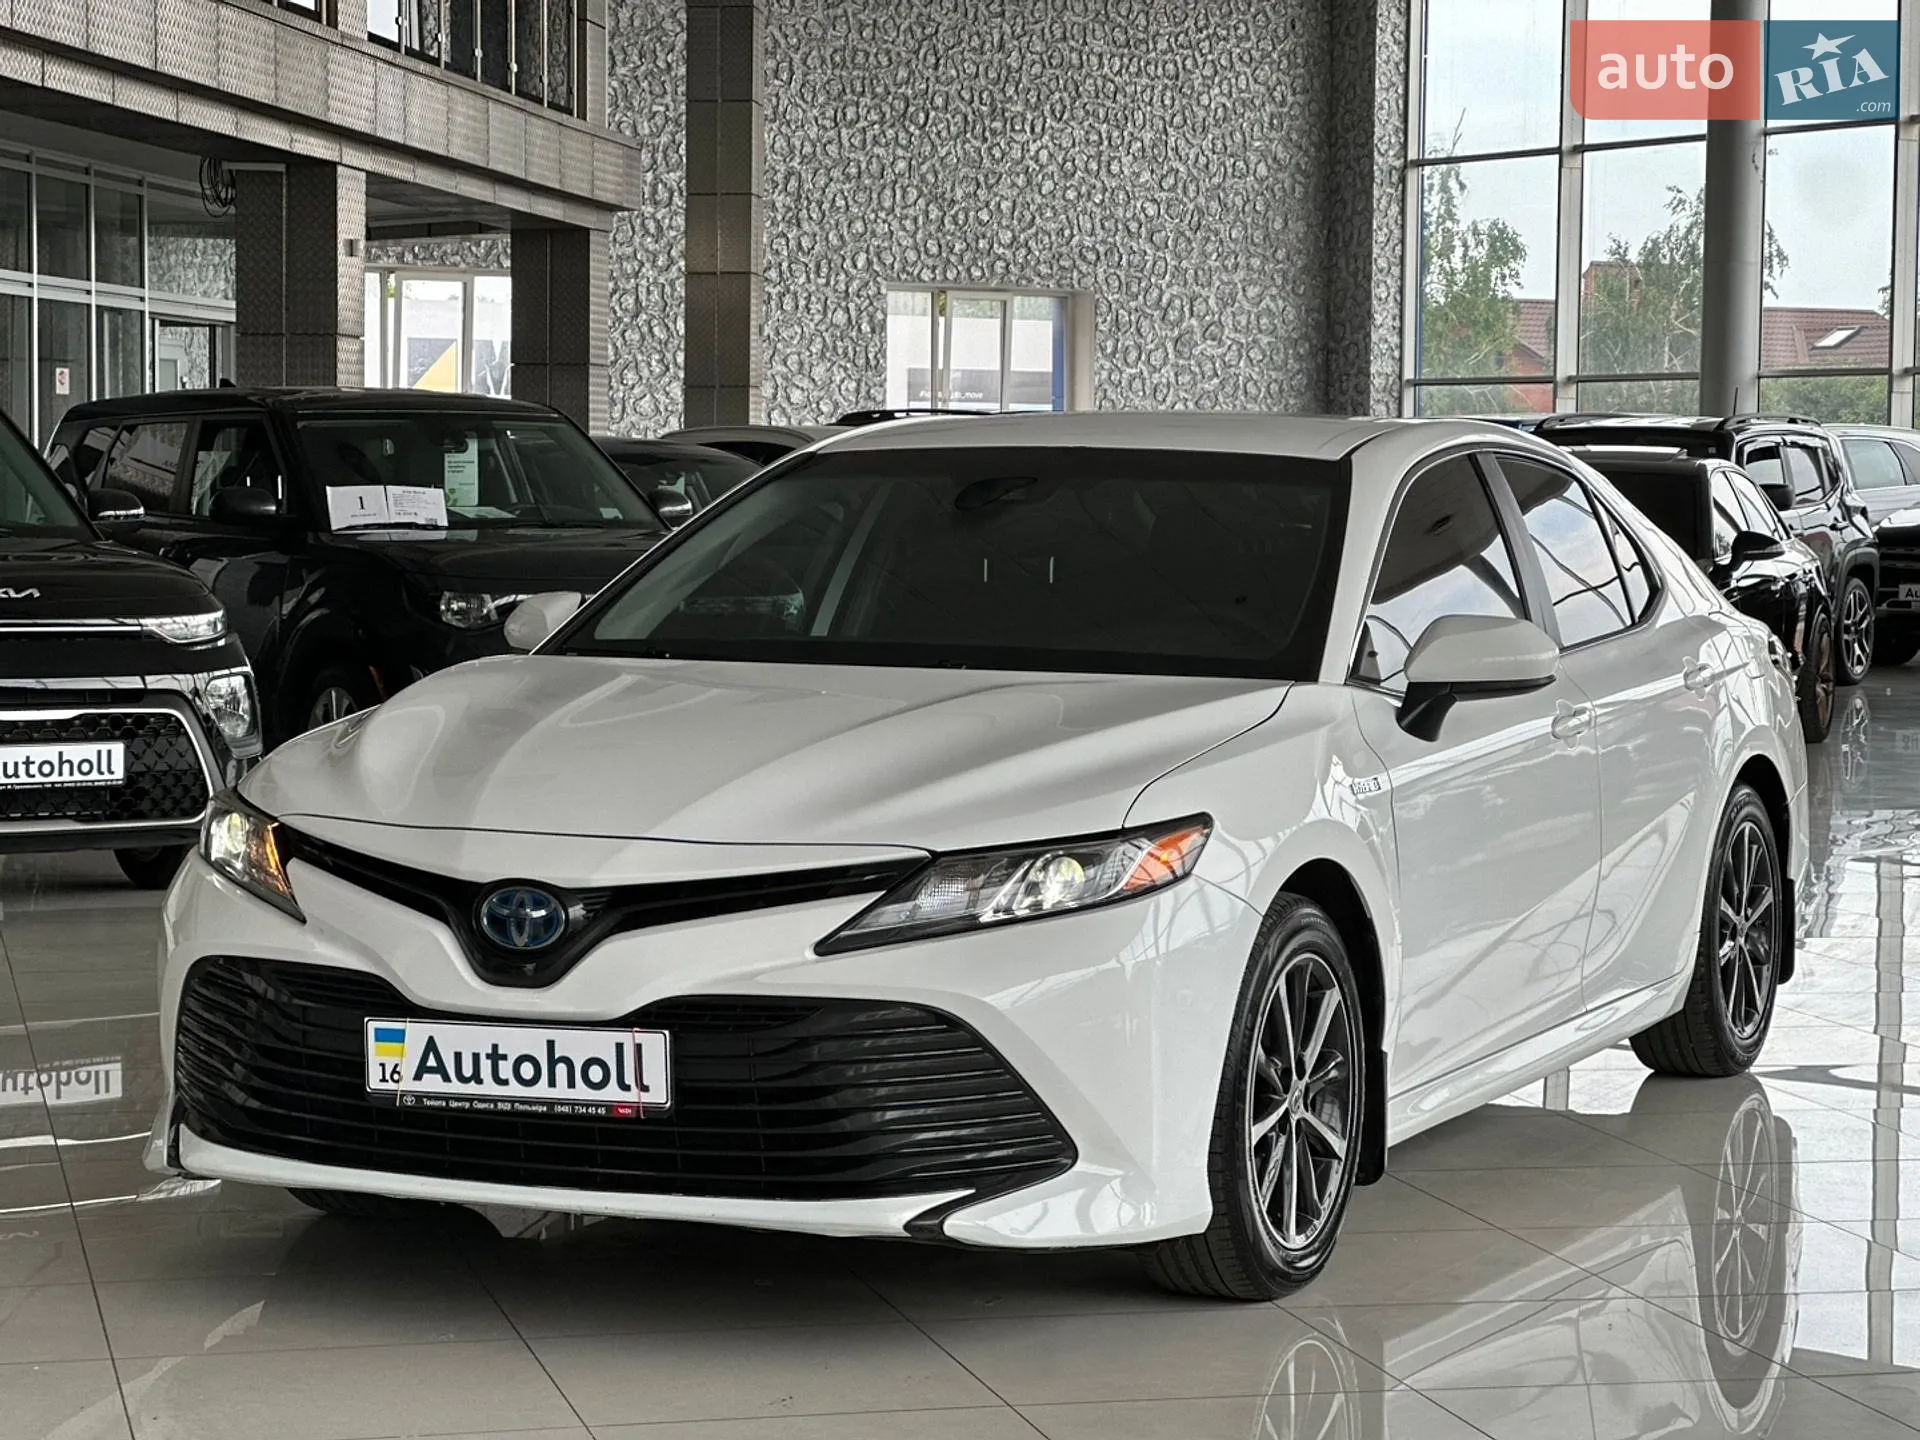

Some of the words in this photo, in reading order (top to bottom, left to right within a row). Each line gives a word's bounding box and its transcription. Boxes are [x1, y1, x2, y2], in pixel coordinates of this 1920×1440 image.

[0, 749, 115, 779] utoholl
[379, 1062, 404, 1084] 16
[412, 1035, 651, 1093] Autoholl
[448, 1099, 470, 1108] Центр
[574, 1105, 587, 1114] 734
